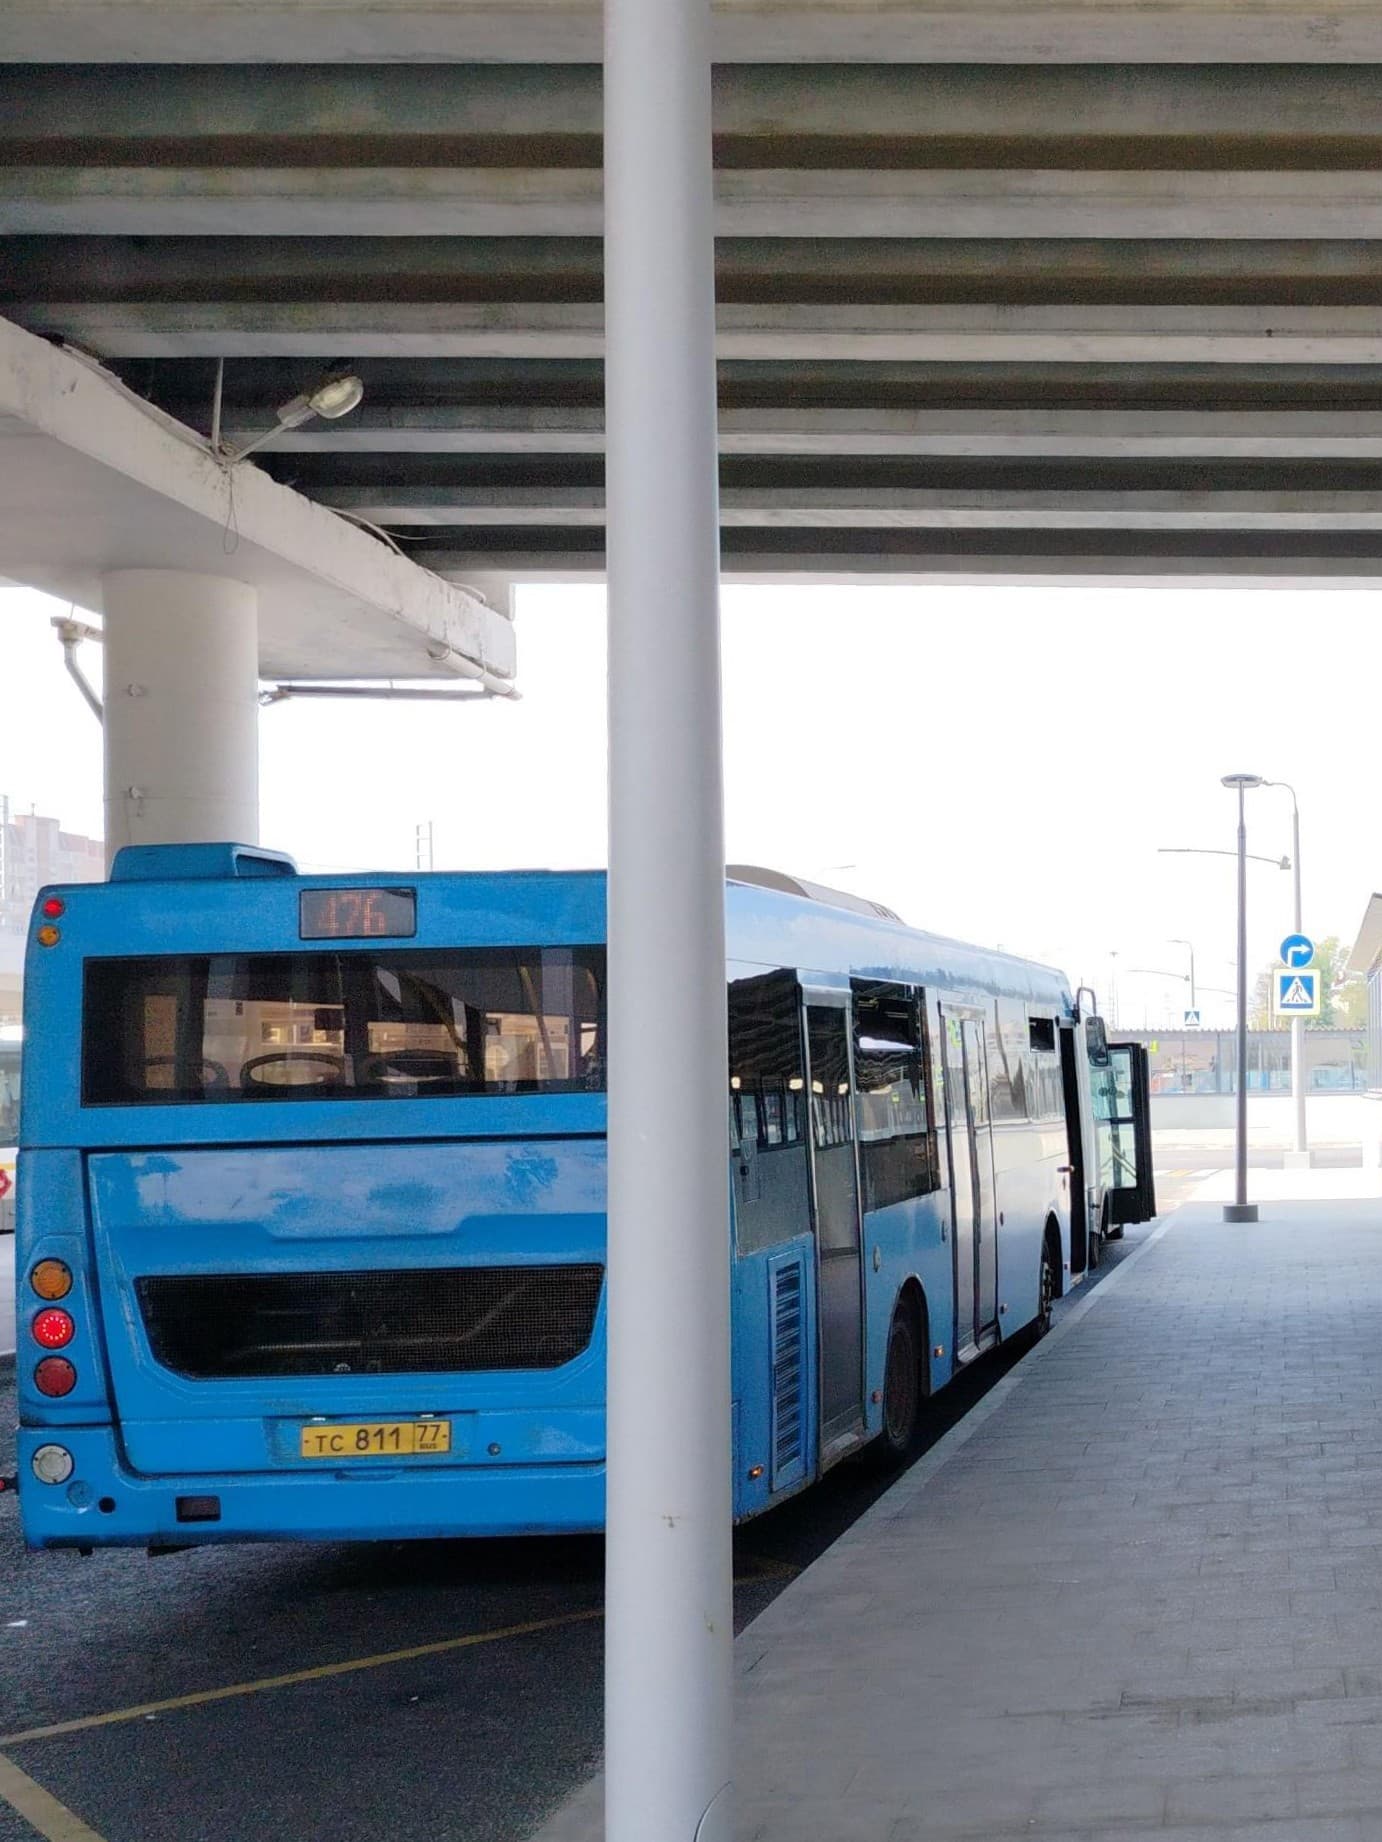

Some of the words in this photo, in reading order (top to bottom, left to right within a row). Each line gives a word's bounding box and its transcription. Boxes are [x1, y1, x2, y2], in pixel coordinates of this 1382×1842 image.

[318, 891, 387, 937] 476
[355, 1426, 401, 1451] 811
[416, 1424, 441, 1443] 77
